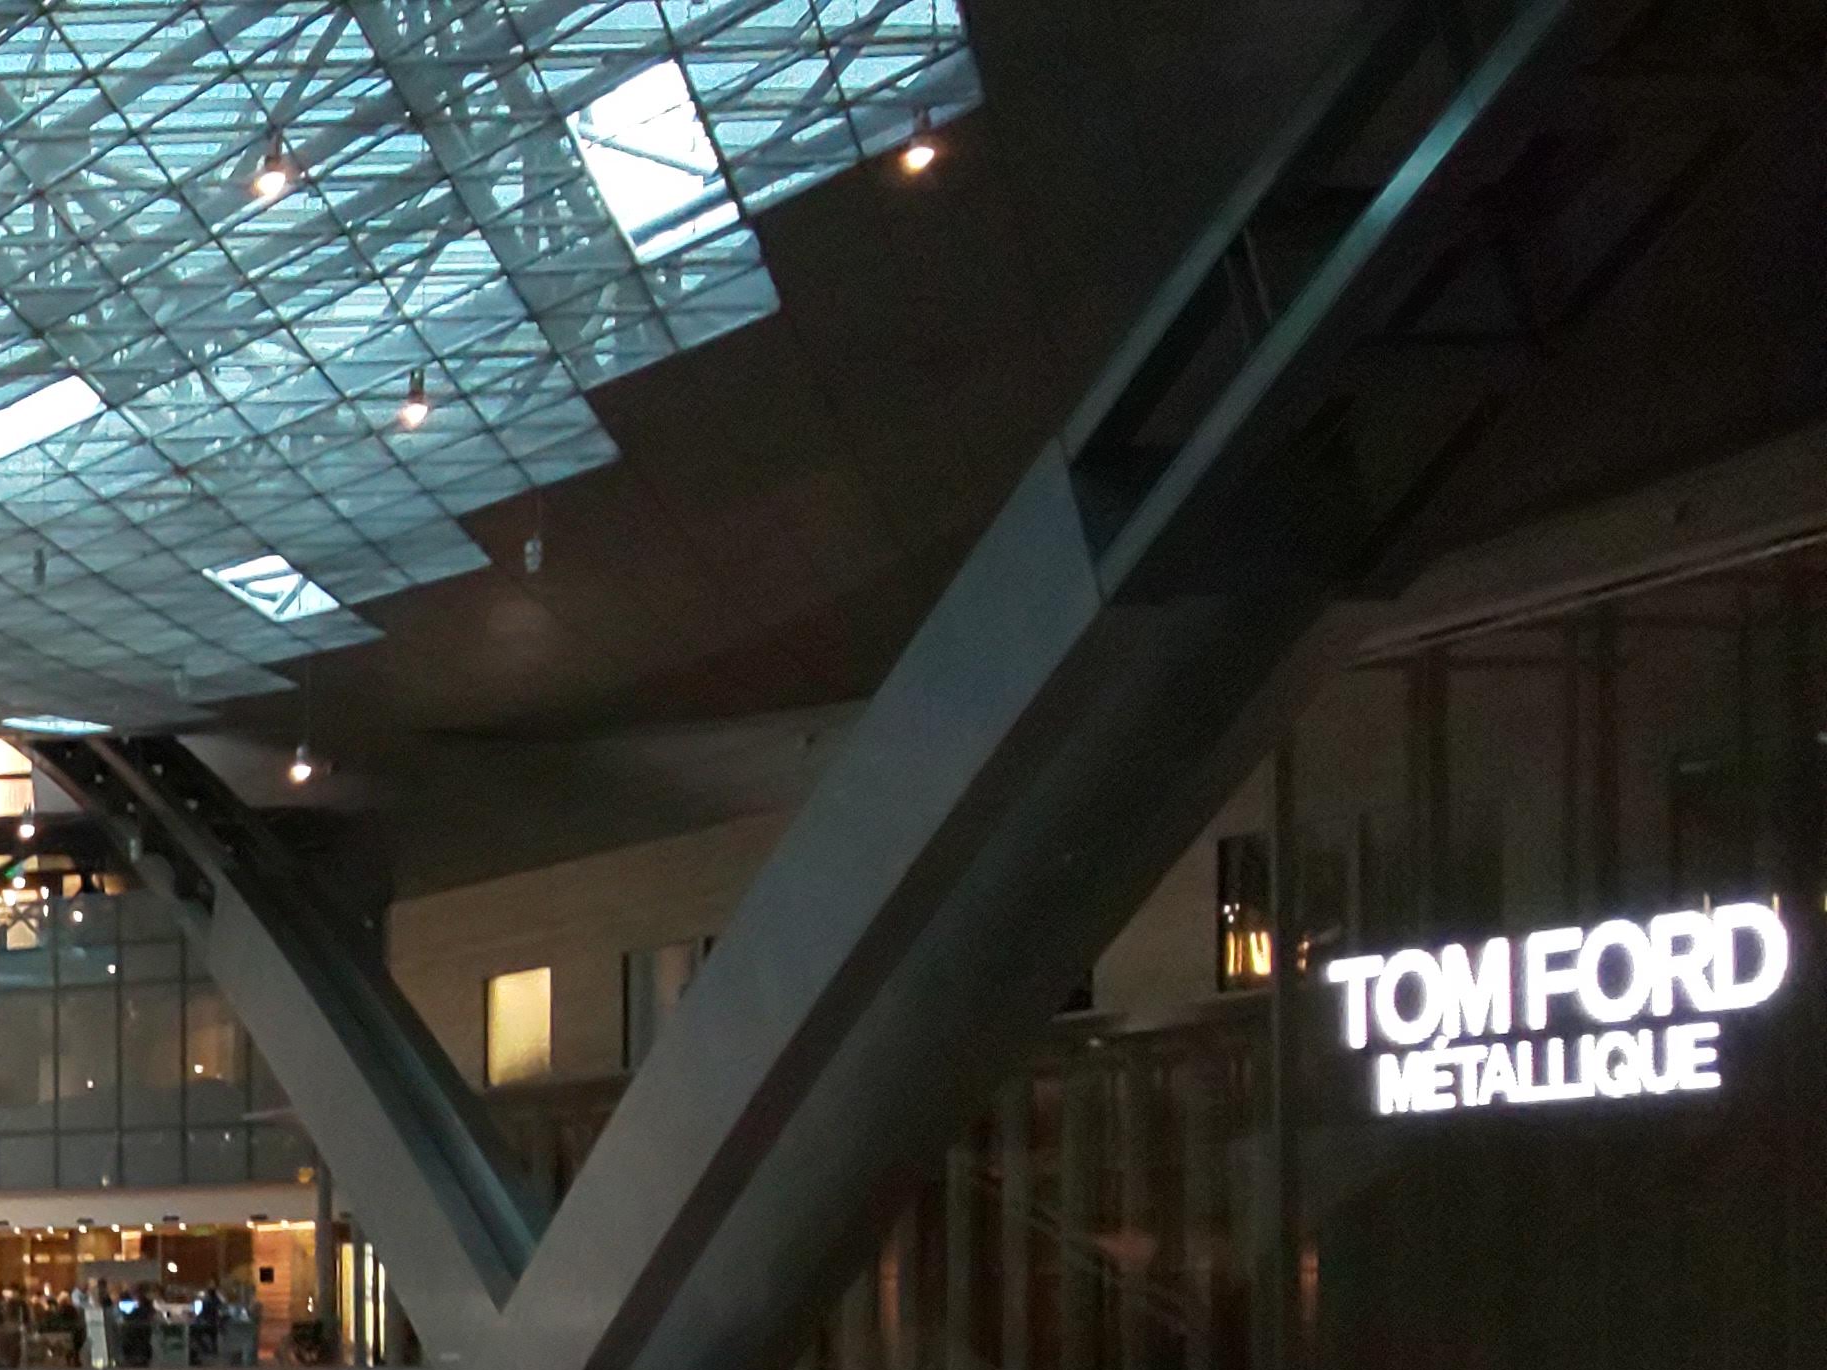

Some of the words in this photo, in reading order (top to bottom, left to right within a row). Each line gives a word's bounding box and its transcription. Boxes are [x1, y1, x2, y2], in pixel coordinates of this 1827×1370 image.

[1326, 937, 1511, 1049] TOM
[1523, 903, 1788, 1030] FORD
[1377, 1019, 1723, 1115] MÉTALLIQUE
